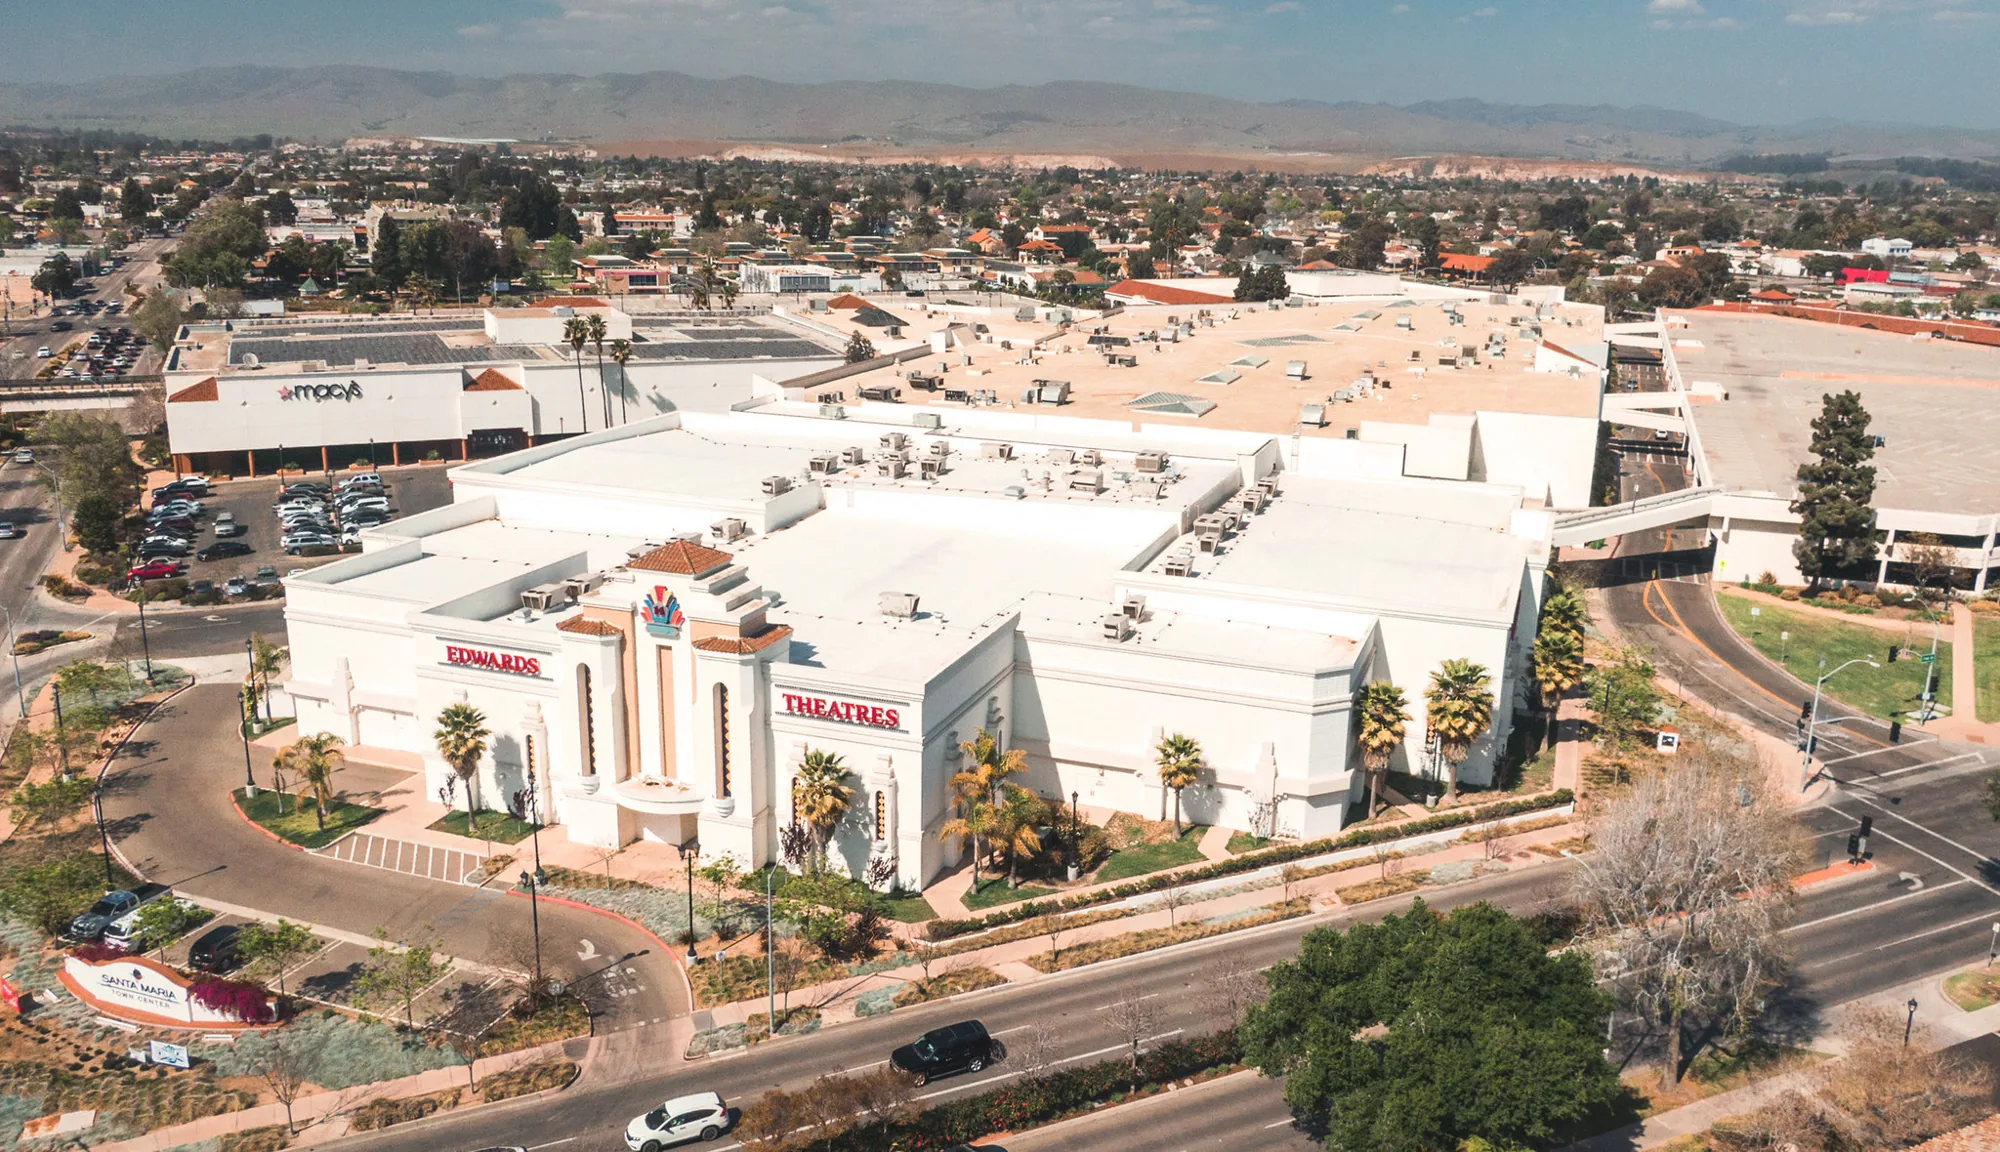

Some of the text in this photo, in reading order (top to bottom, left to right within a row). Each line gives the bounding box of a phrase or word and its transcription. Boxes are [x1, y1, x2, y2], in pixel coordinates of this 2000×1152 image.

[446, 645, 540, 675] EDWARDS
[782, 693, 900, 728] THEATRES
[102, 974, 177, 1000] SANTA MARIA
[111, 989, 170, 1009] TOWN CENTER
